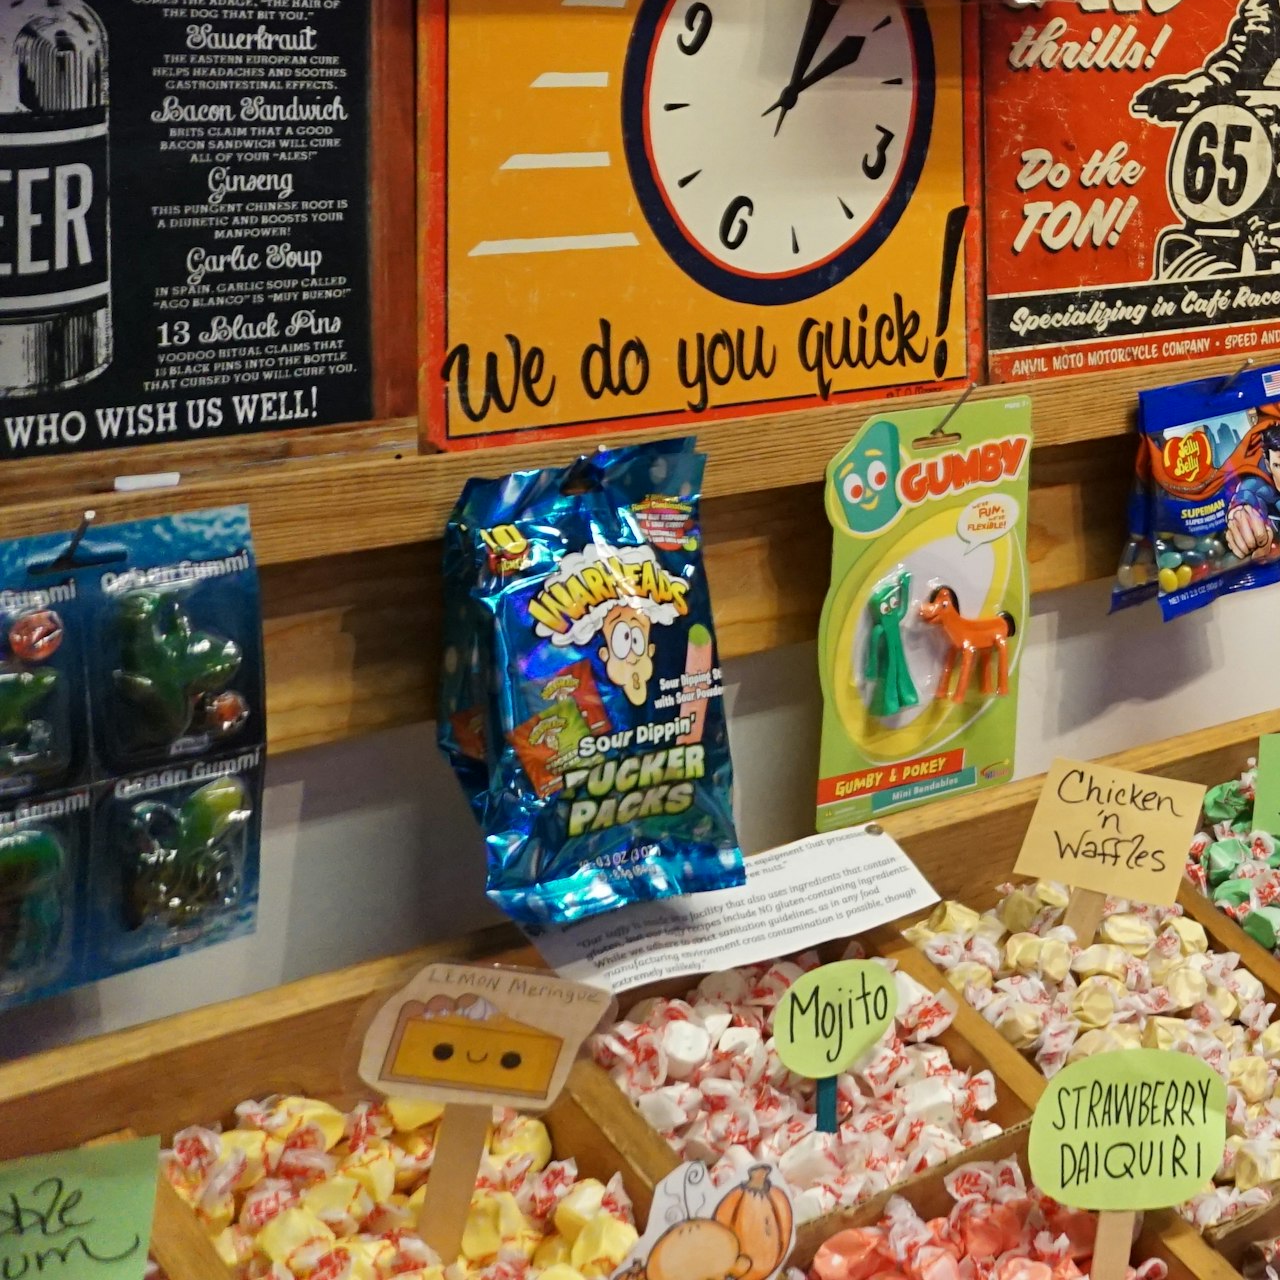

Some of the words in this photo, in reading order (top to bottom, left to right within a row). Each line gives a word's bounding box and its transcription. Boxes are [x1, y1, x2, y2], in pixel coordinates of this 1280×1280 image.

[185, 23, 318, 53] Sauerkraut
[1007, 17, 1173, 72] thrills!
[1017, 148, 1071, 190] Do
[1080, 140, 1146, 188] the
[1182, 120, 1253, 208] 65
[1011, 195, 1139, 254] TON!
[185, 245, 260, 283] Garlic
[265, 241, 324, 278] Soup
[440, 332, 556, 423] We
[580, 317, 651, 399] do
[678, 323, 777, 412] you
[798, 204, 971, 401] quick!
[1010, 294, 1148, 336] Specializing
[1152, 293, 1176, 316] in
[1180, 285, 1231, 318] Café
[6, 409, 88, 449] WHO
[95, 399, 178, 441] WISH
[186, 397, 224, 431] US
[232, 384, 320, 425] WELL!
[899, 436, 1029, 504] GUMBY
[526, 555, 690, 637] WARHEADS
[1056, 768, 1185, 820] Chicken
[1053, 827, 1167, 875] Waffles
[428, 966, 501, 992] LEMON
[507, 980, 602, 1006] Meringue
[788, 981, 890, 1063] Mojito
[1050, 1078, 1214, 1133] STRAWBERRY
[1058, 1133, 1203, 1190] DAIQUIRI
